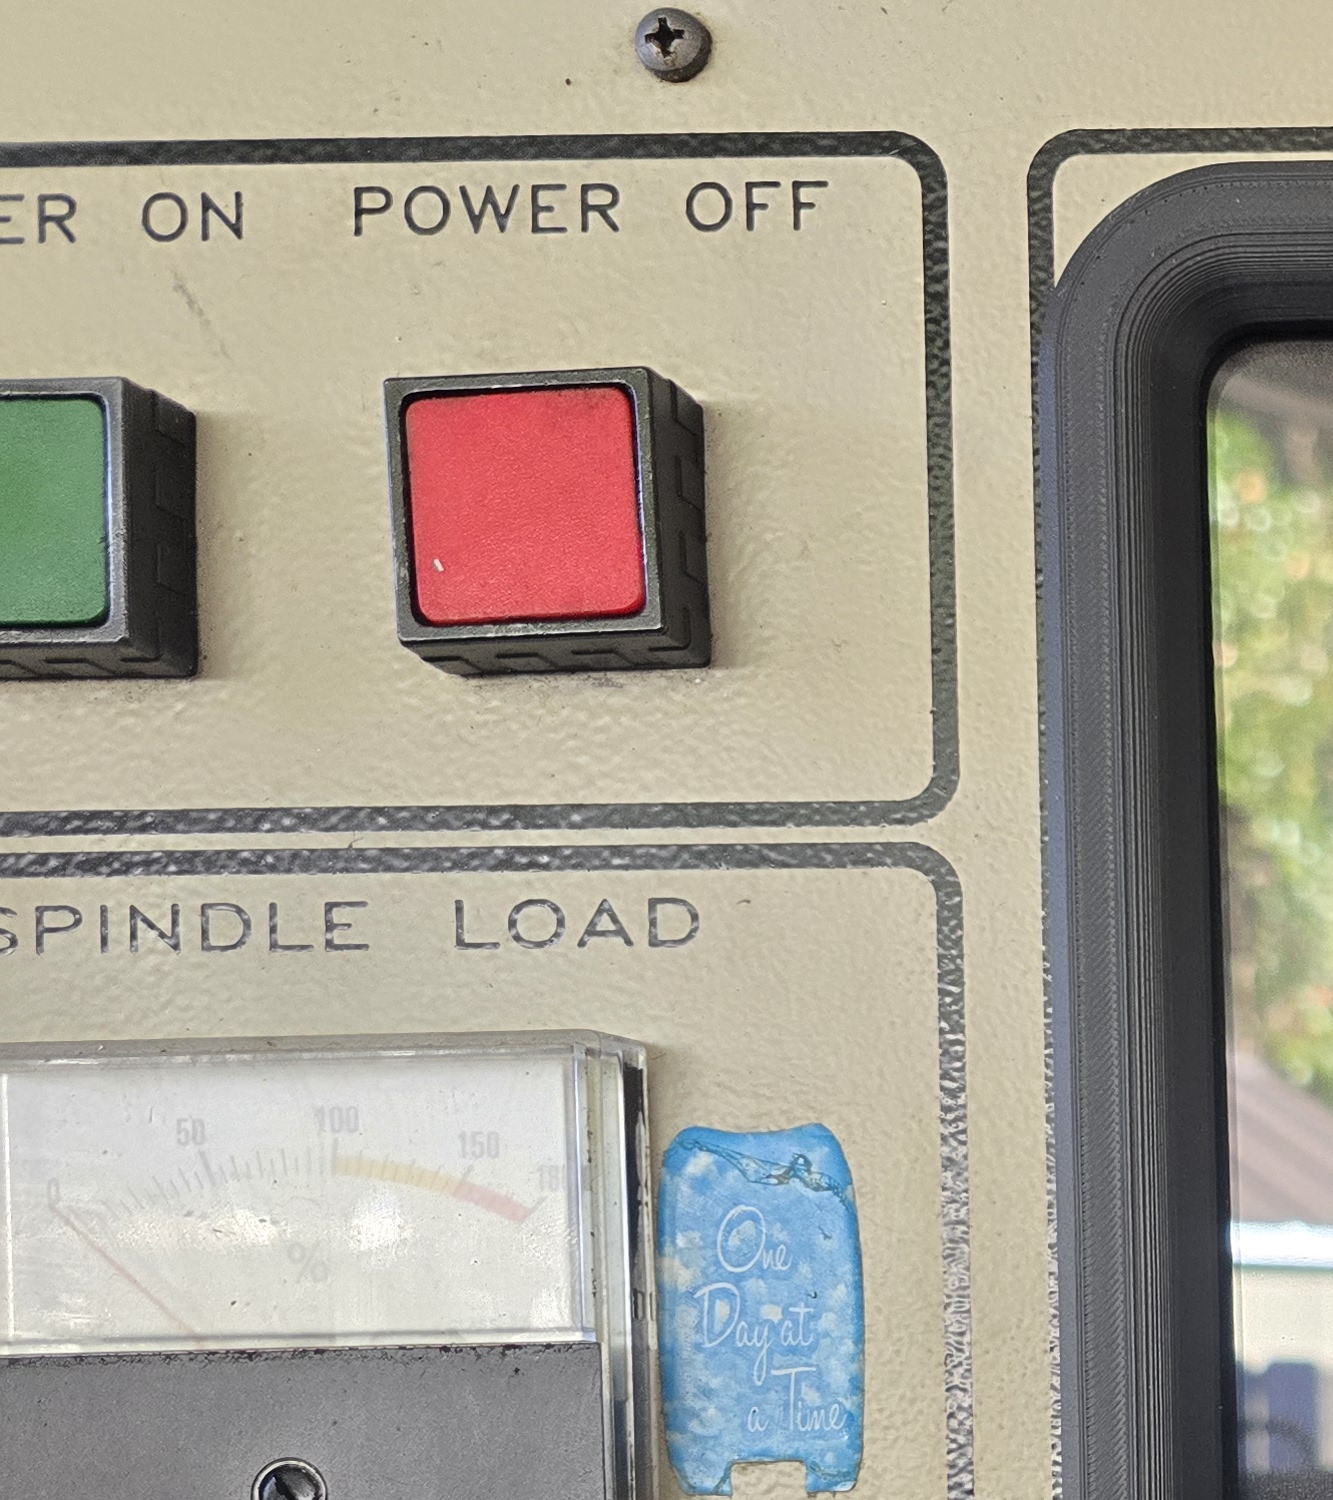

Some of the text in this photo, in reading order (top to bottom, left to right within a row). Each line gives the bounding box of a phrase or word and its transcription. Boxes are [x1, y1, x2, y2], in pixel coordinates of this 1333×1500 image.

[141, 190, 245, 243] ON
[353, 180, 829, 237] POWER OFF
[0, 896, 700, 956] SPINDLE LOAD
[176, 1119, 207, 1145] 50
[316, 1106, 360, 1134] 100
[457, 1131, 500, 1159] 150
[717, 1205, 791, 1273] One
[694, 1282, 815, 1386] Day at
[748, 1366, 847, 1432] a Time
